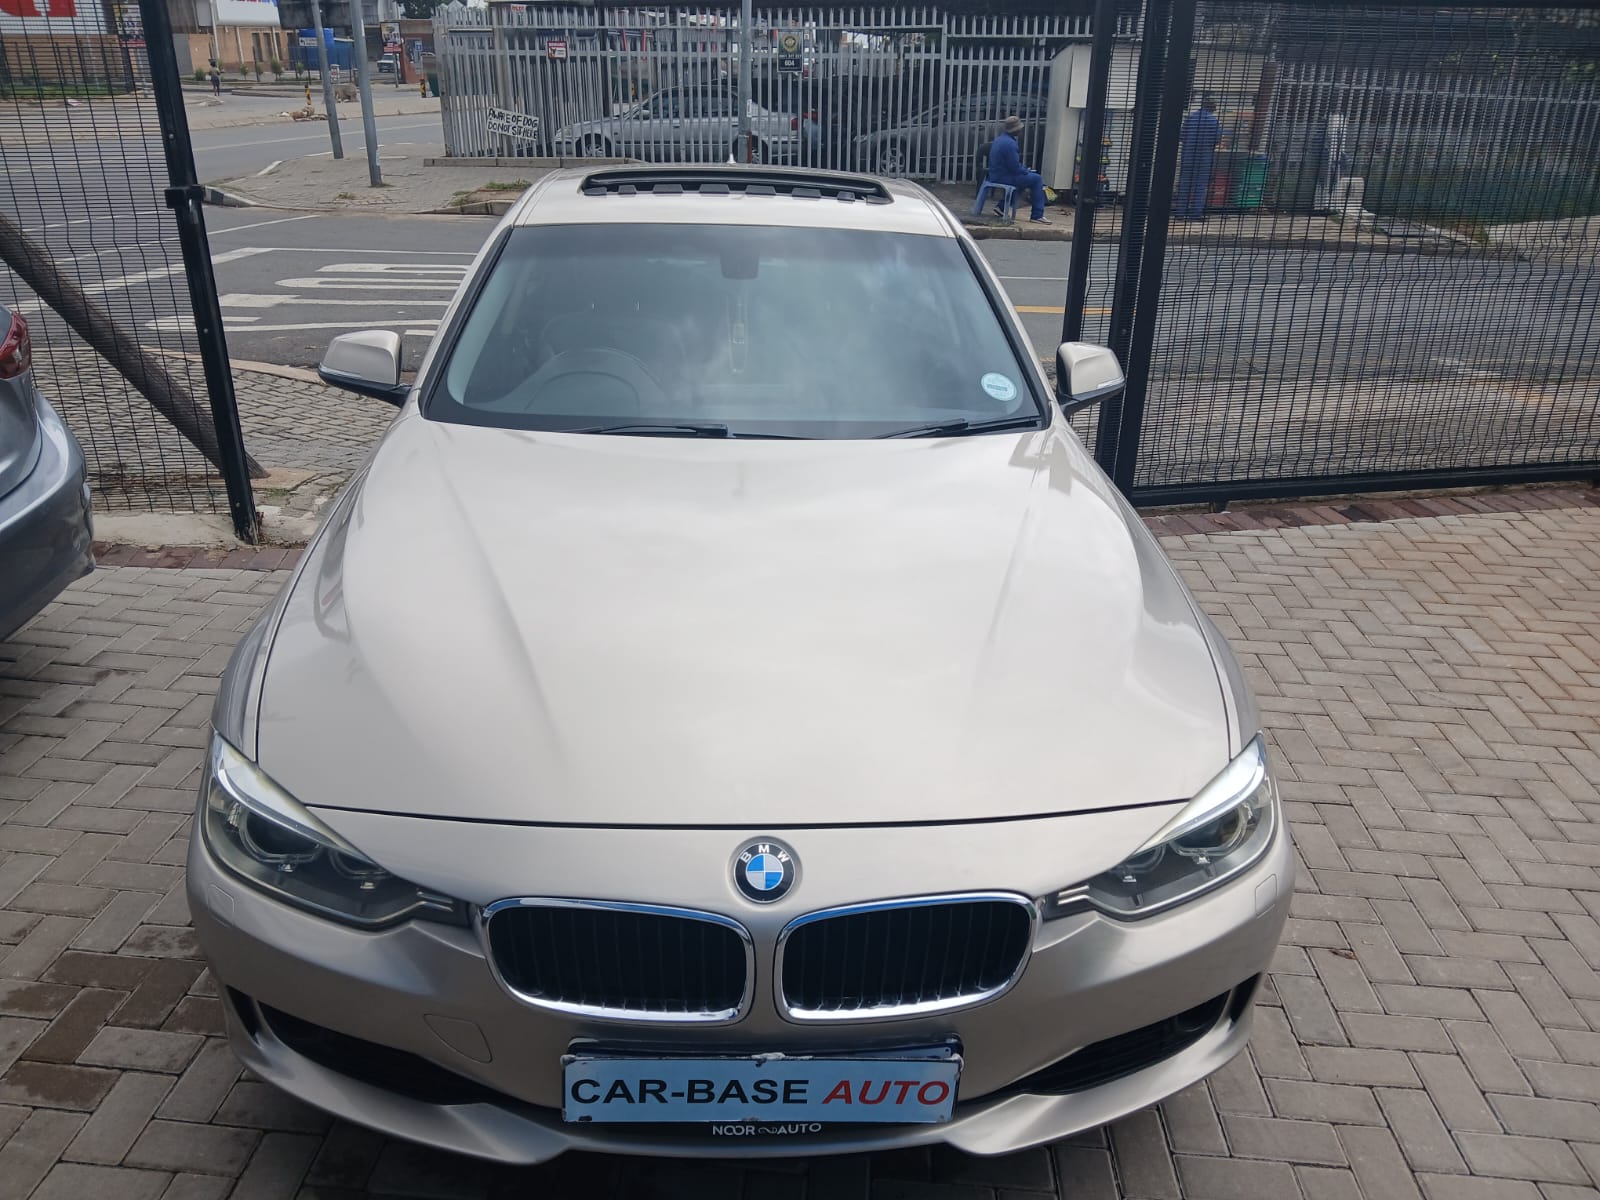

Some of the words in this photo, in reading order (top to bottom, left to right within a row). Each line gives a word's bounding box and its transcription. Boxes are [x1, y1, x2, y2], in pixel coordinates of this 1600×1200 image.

[511, 115, 522, 125] OF
[523, 117, 538, 128] DOG
[740, 845, 790, 863] BMW
[571, 1079, 808, 1105] CAR-BASE
[822, 1080, 950, 1105] AUTO
[712, 1125, 755, 1136] NOOR
[777, 1123, 822, 1135] AUTO
